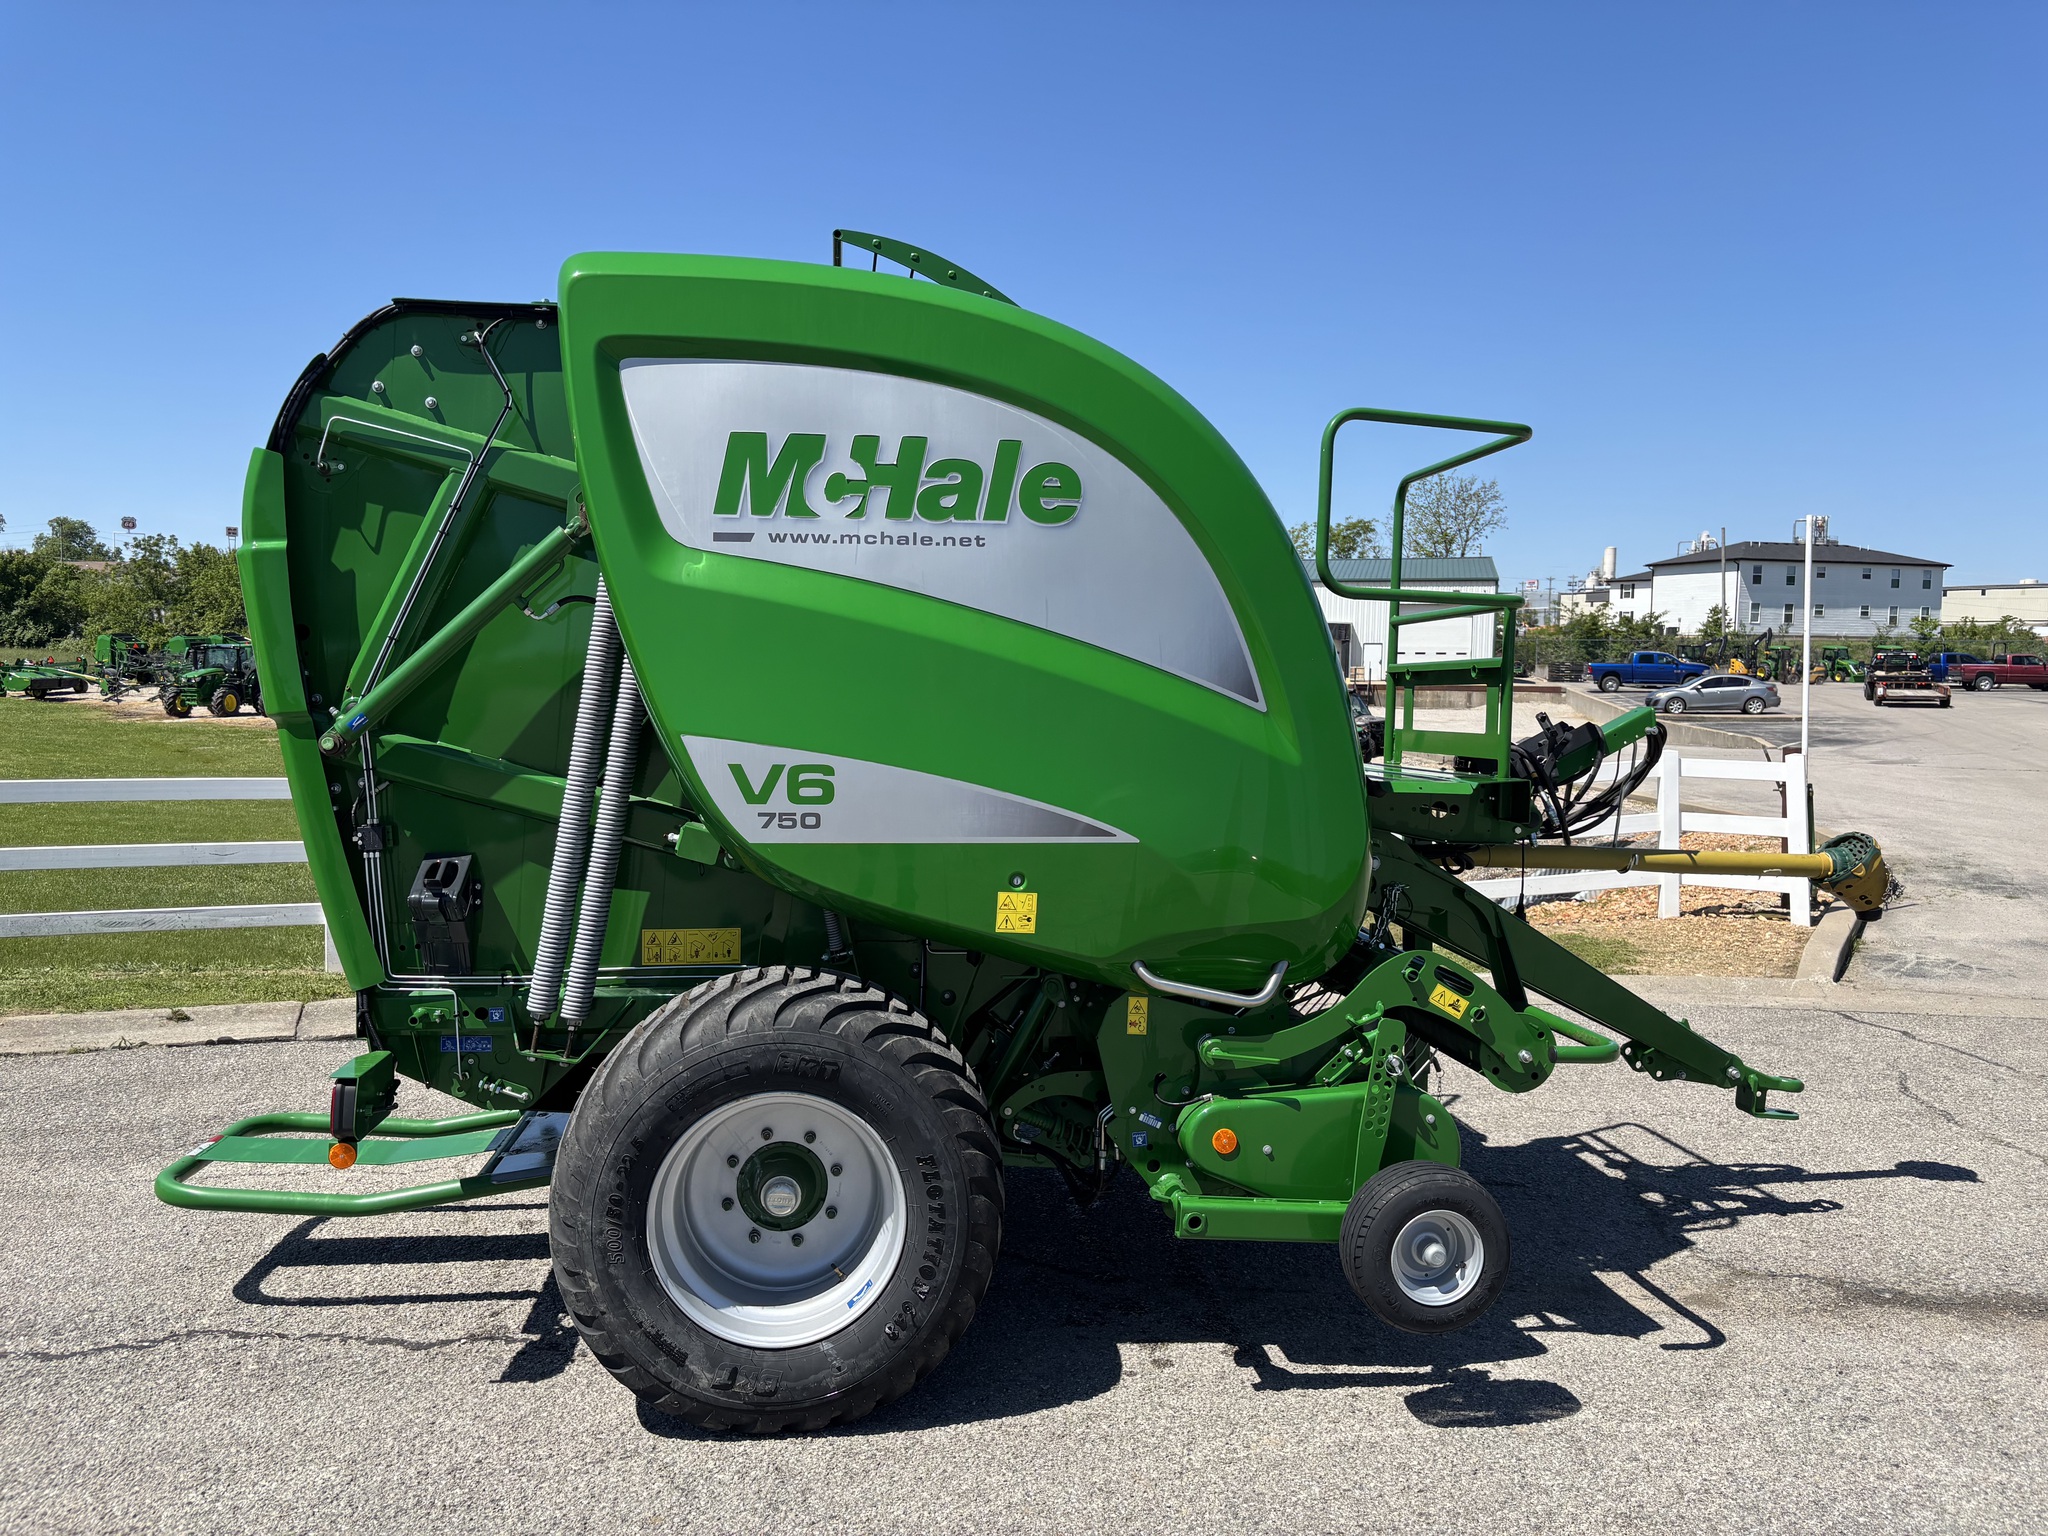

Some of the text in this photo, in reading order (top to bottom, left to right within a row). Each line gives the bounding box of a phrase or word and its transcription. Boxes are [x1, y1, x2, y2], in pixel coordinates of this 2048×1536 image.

[713, 431, 1083, 526] McHale
[768, 531, 987, 548] www.mchale.net
[727, 763, 835, 805] V6
[757, 812, 821, 830] 750
[773, 1051, 844, 1083] BKT
[912, 1153, 947, 1302] FLOTATION
